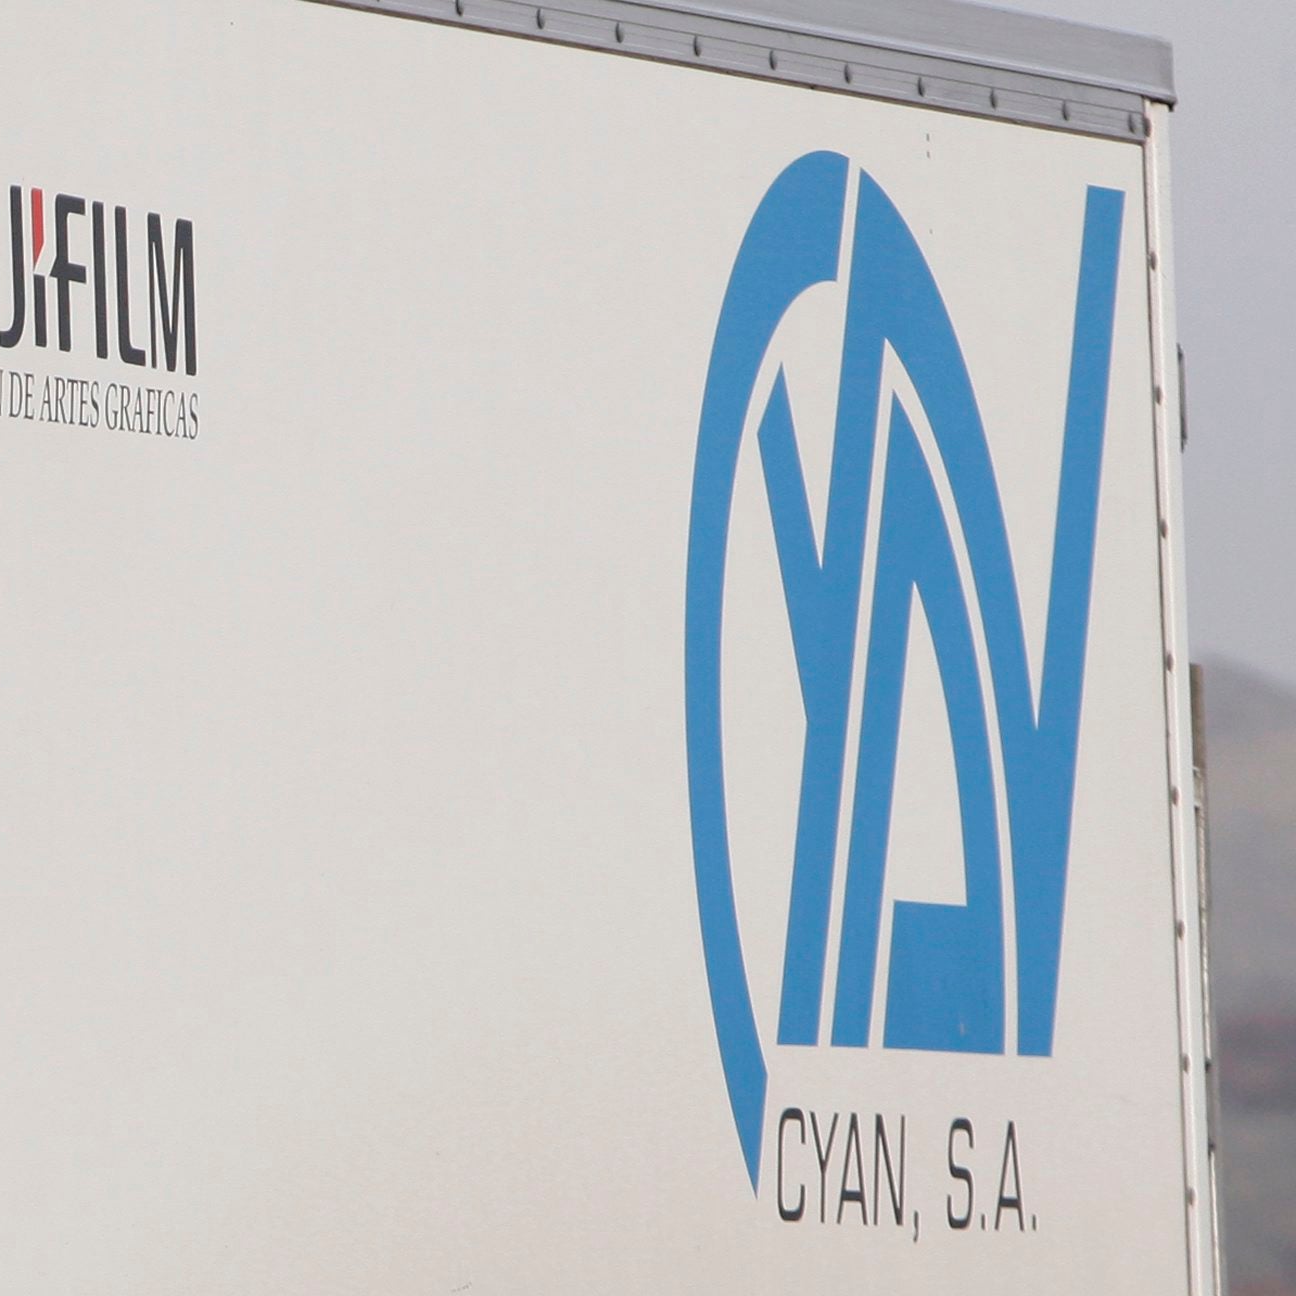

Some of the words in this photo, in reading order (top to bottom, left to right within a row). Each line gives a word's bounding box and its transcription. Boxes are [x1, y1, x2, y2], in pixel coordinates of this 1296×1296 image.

[8, 371, 35, 421] DE
[39, 375, 100, 428] ARTES
[105, 383, 199, 440] GRAFICAS
[777, 1107, 920, 1242] CYAN,
[947, 1117, 1039, 1232] S.A.
